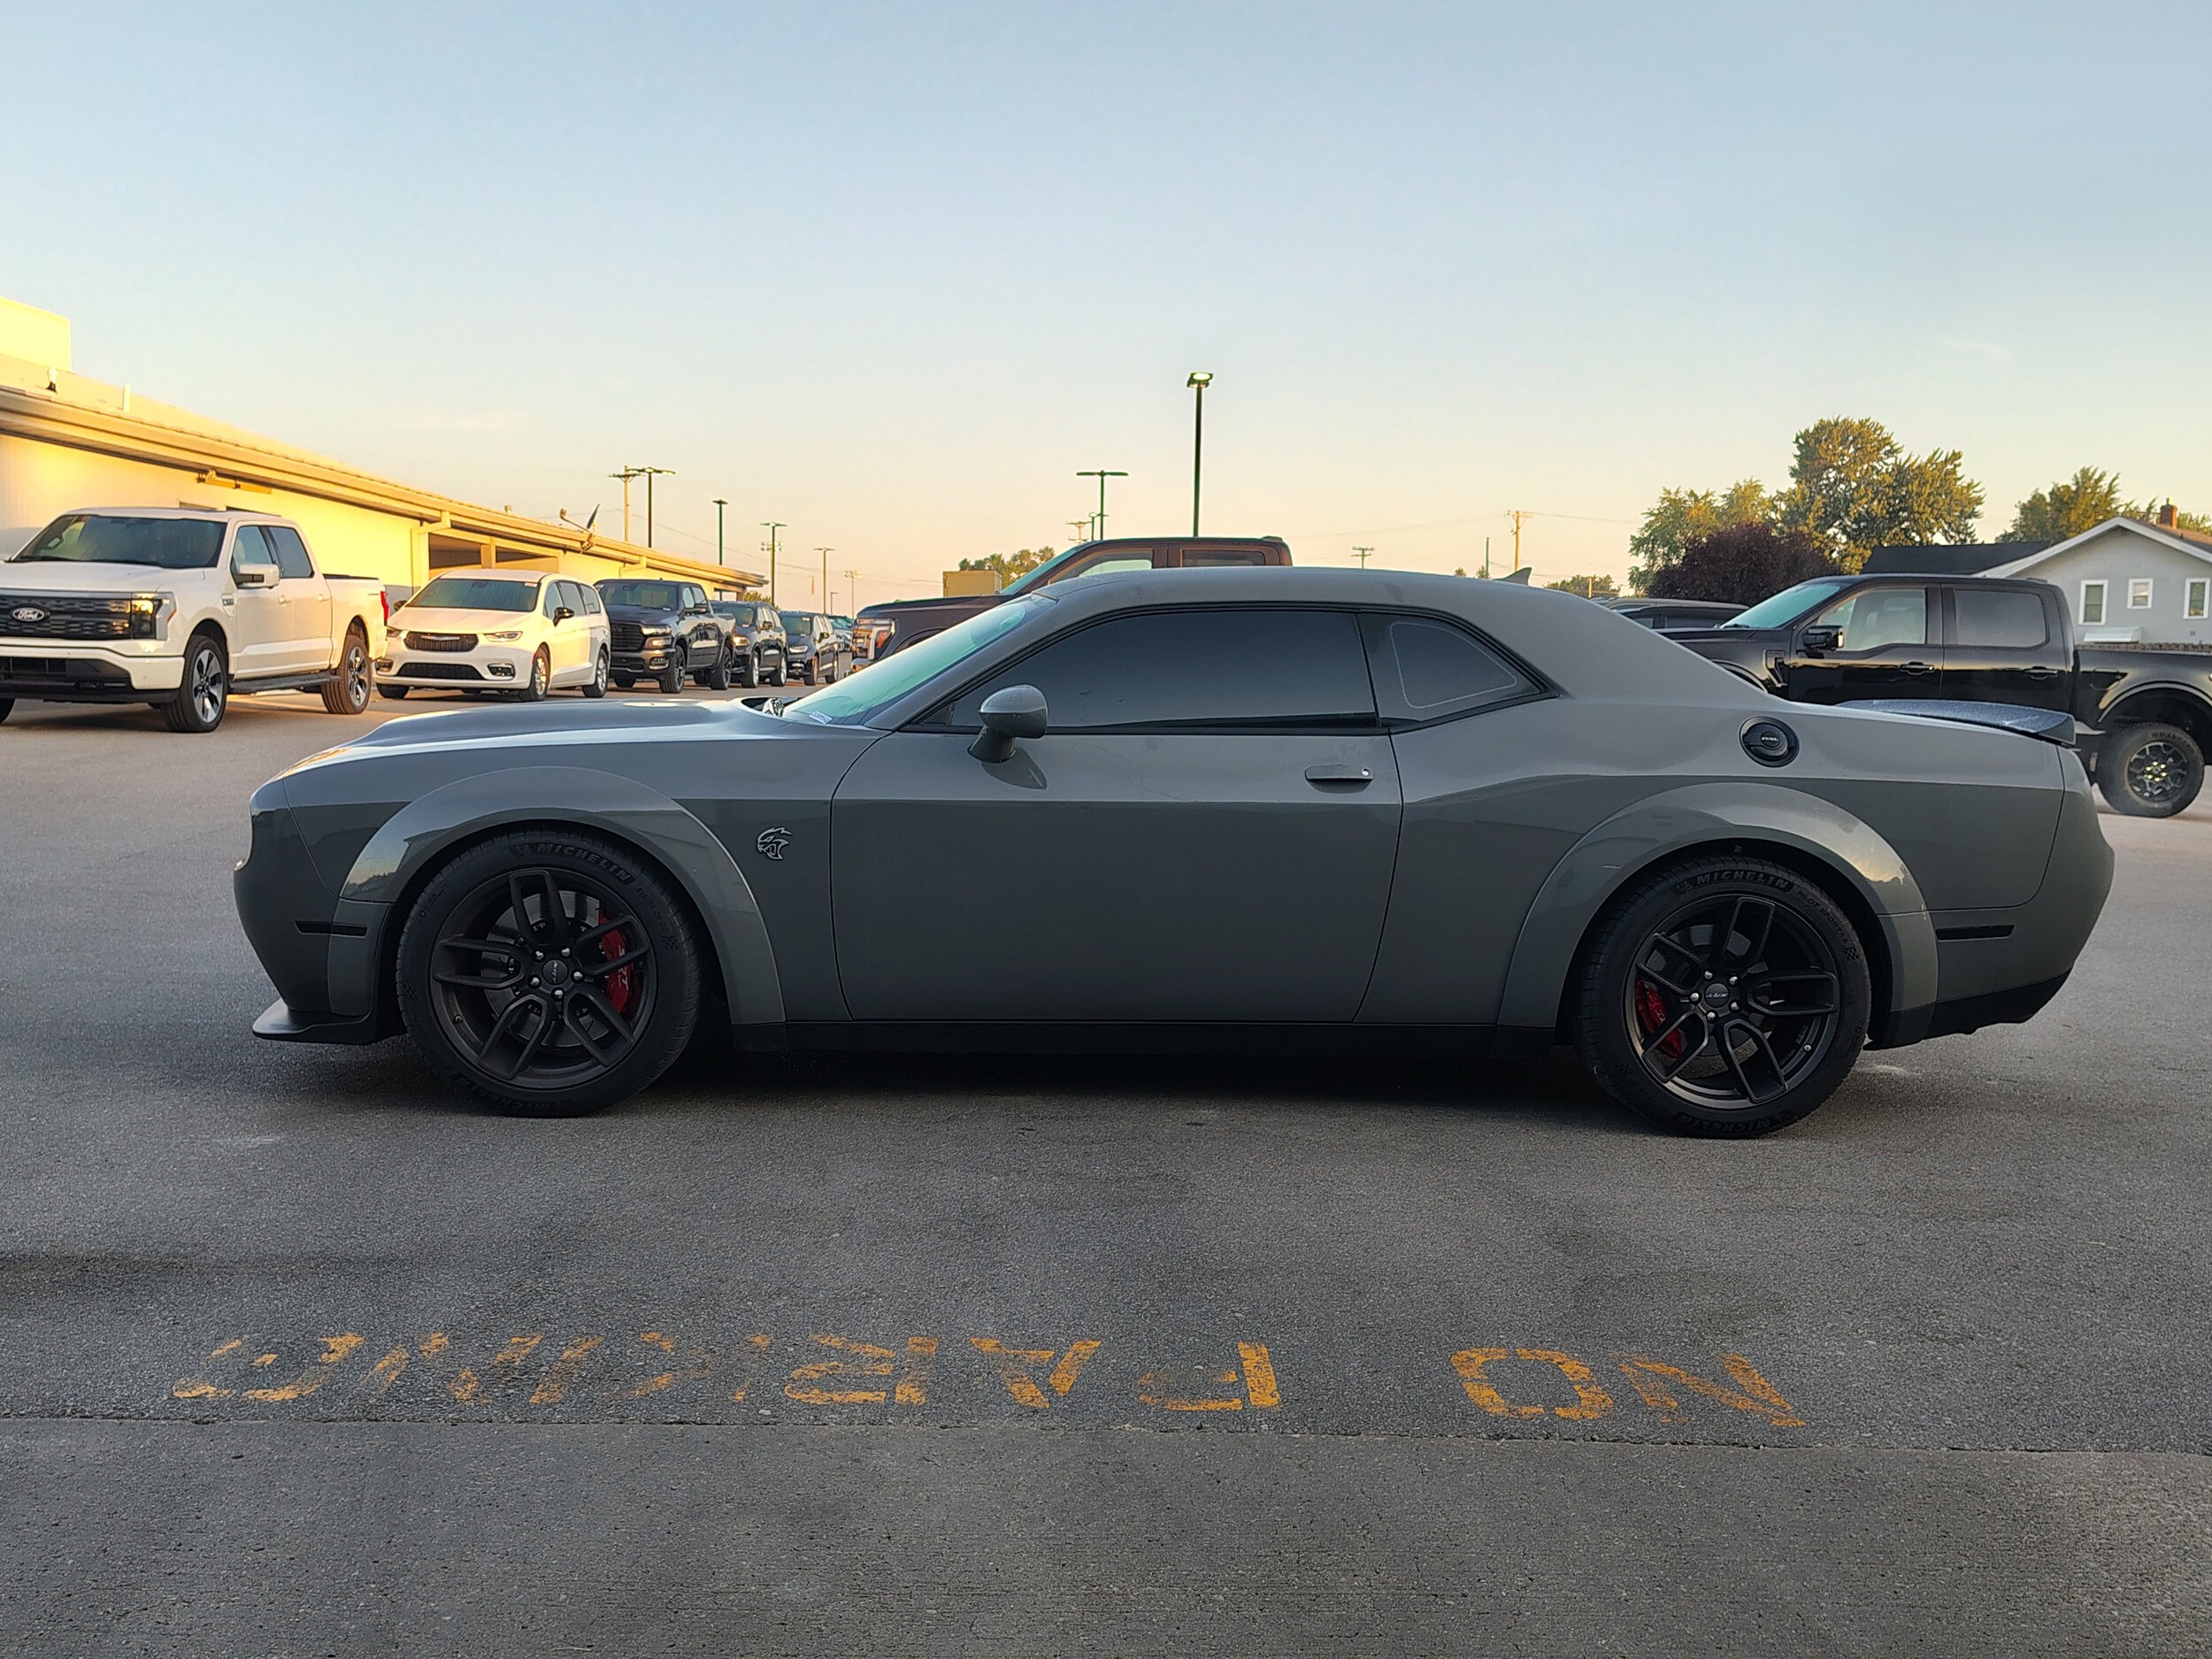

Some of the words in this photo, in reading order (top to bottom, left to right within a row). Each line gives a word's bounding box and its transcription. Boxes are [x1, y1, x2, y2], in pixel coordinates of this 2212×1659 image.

[536, 842, 632, 883] MICHELIN
[1696, 871, 1789, 890] MICHELIN
[1797, 890, 1820, 908] PILOT
[1449, 1347, 1808, 1427] NO
